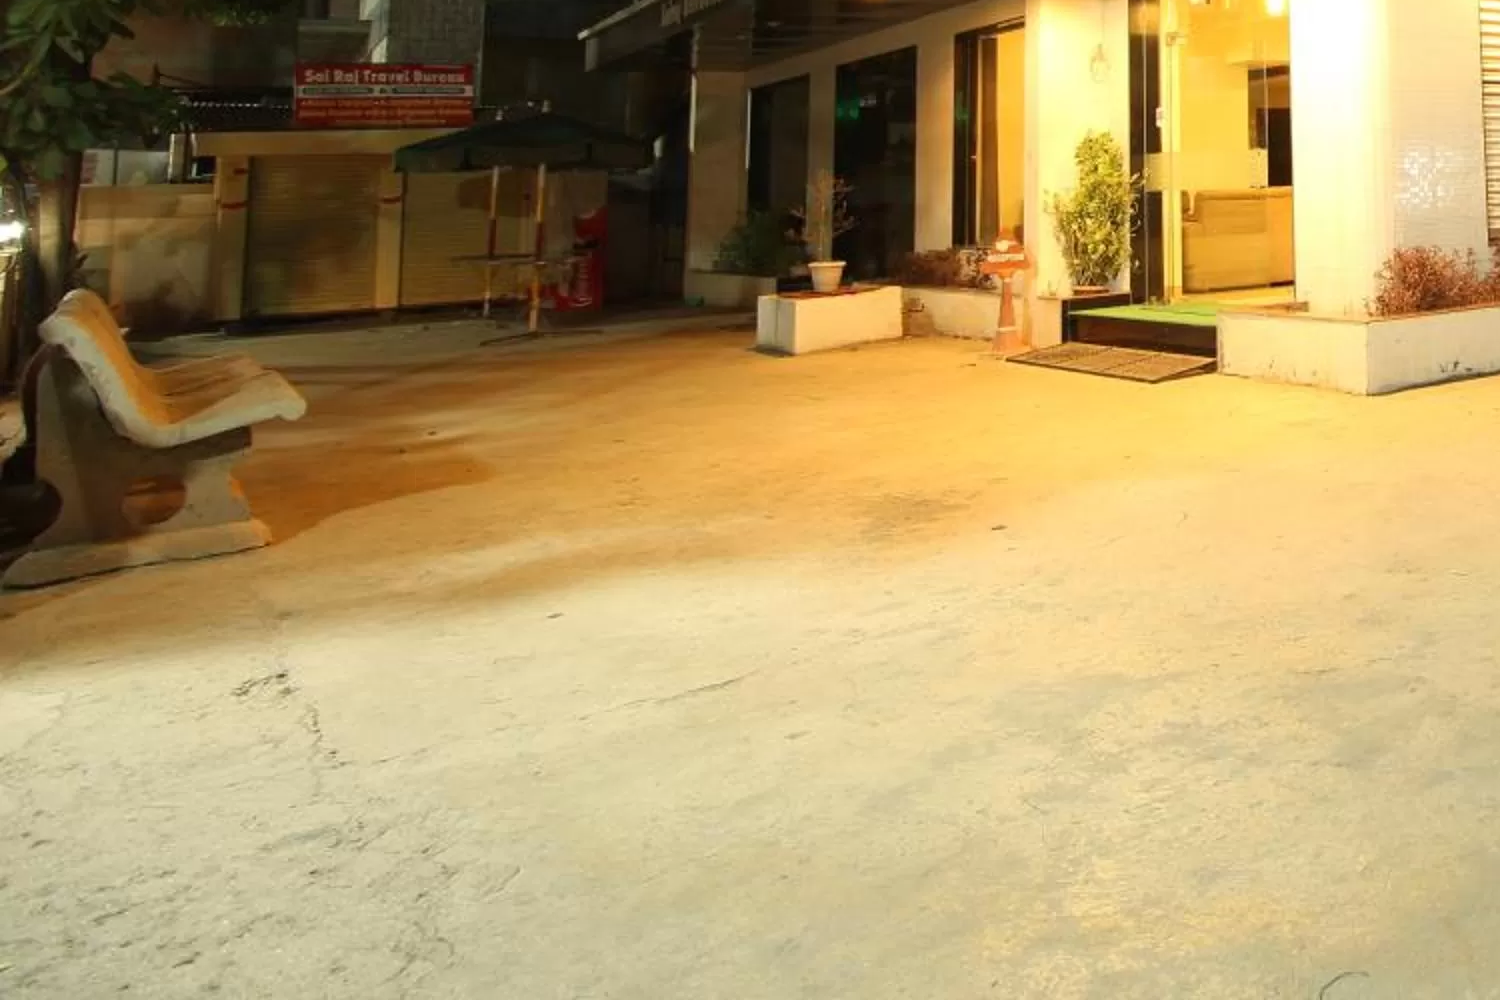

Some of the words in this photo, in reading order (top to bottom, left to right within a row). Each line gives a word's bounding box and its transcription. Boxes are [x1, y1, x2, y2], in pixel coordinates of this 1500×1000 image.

[304, 69, 330, 83] Sai
[333, 69, 358, 85] Raj
[363, 69, 409, 83] Travel
